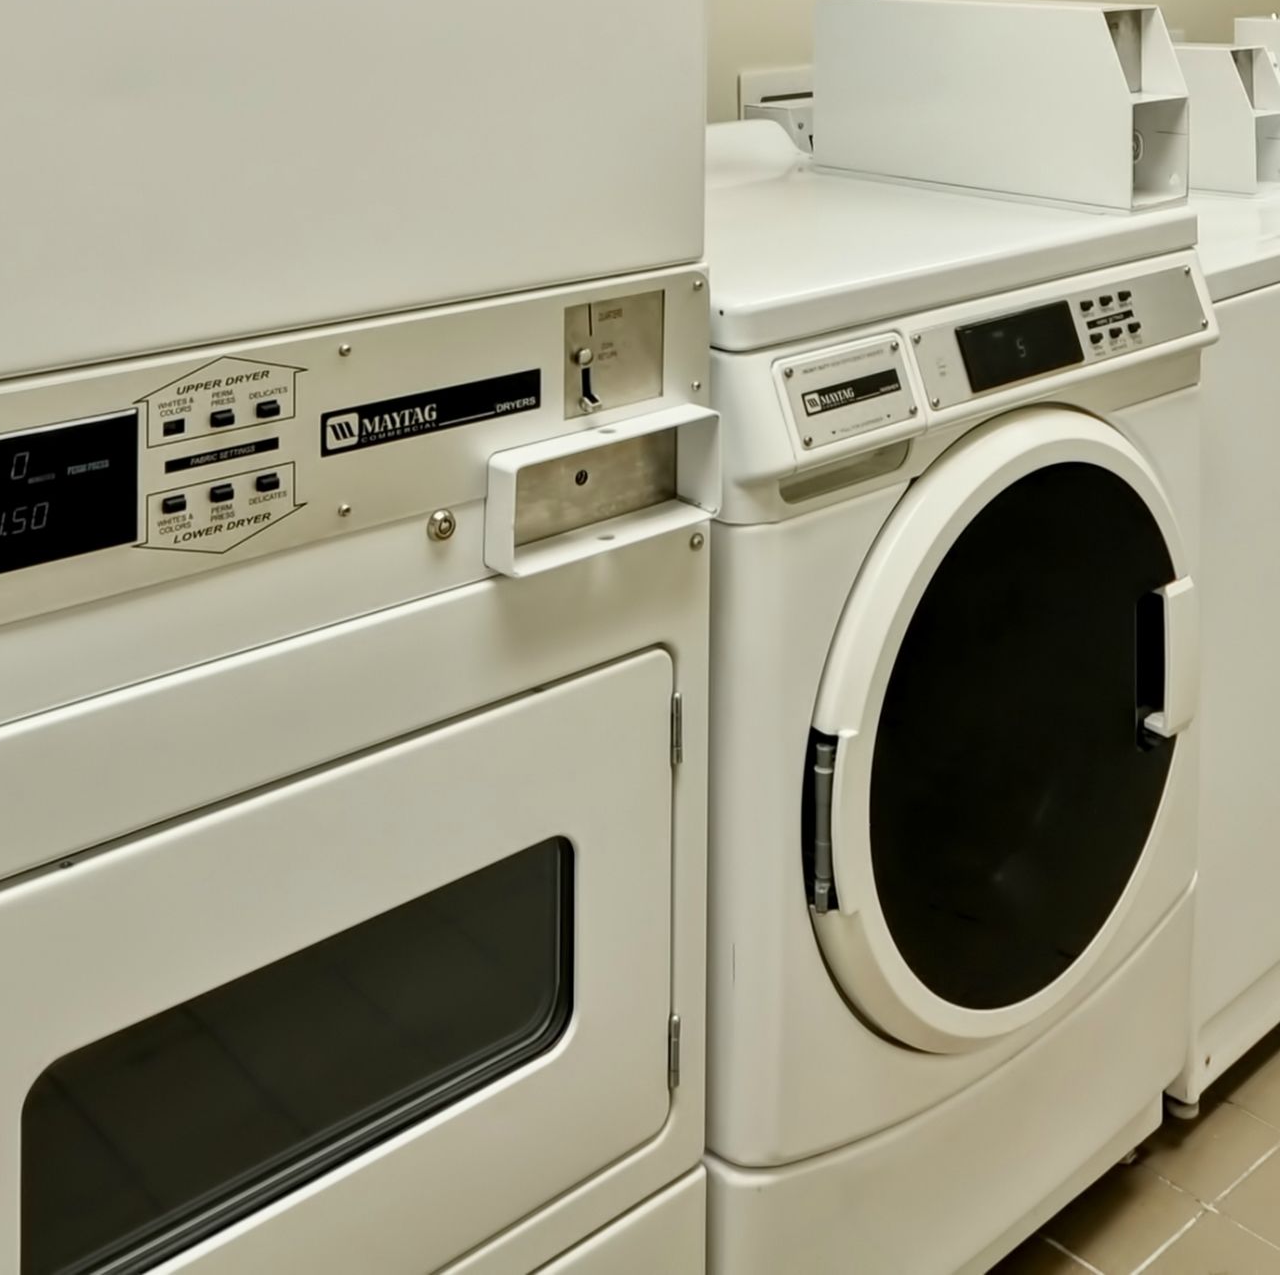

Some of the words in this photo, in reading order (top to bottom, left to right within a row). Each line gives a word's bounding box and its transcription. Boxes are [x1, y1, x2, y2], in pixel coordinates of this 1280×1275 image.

[176, 378, 222, 396] UPPER
[225, 370, 270, 386] DRYER
[248, 386, 288, 400] DELICATES
[820, 387, 855, 406] MAYTAG
[158, 398, 187, 410] WHITES
[159, 405, 192, 418] COLORS
[495, 396, 536, 413] DRYERS
[361, 403, 438, 437] MAYTAG
[361, 421, 437, 443] COMMERCIAL
[190, 453, 218, 466] FABRIC
[219, 445, 256, 459] SETTINGS
[10, 451, 30, 480] 0
[248, 490, 287, 506] DELICATES
[0, 501, 49, 536] 1.50
[157, 515, 185, 528] WHITES
[159, 521, 192, 535] COLORS
[173, 523, 223, 544] LOWER
[226, 512, 272, 531] DRYER
